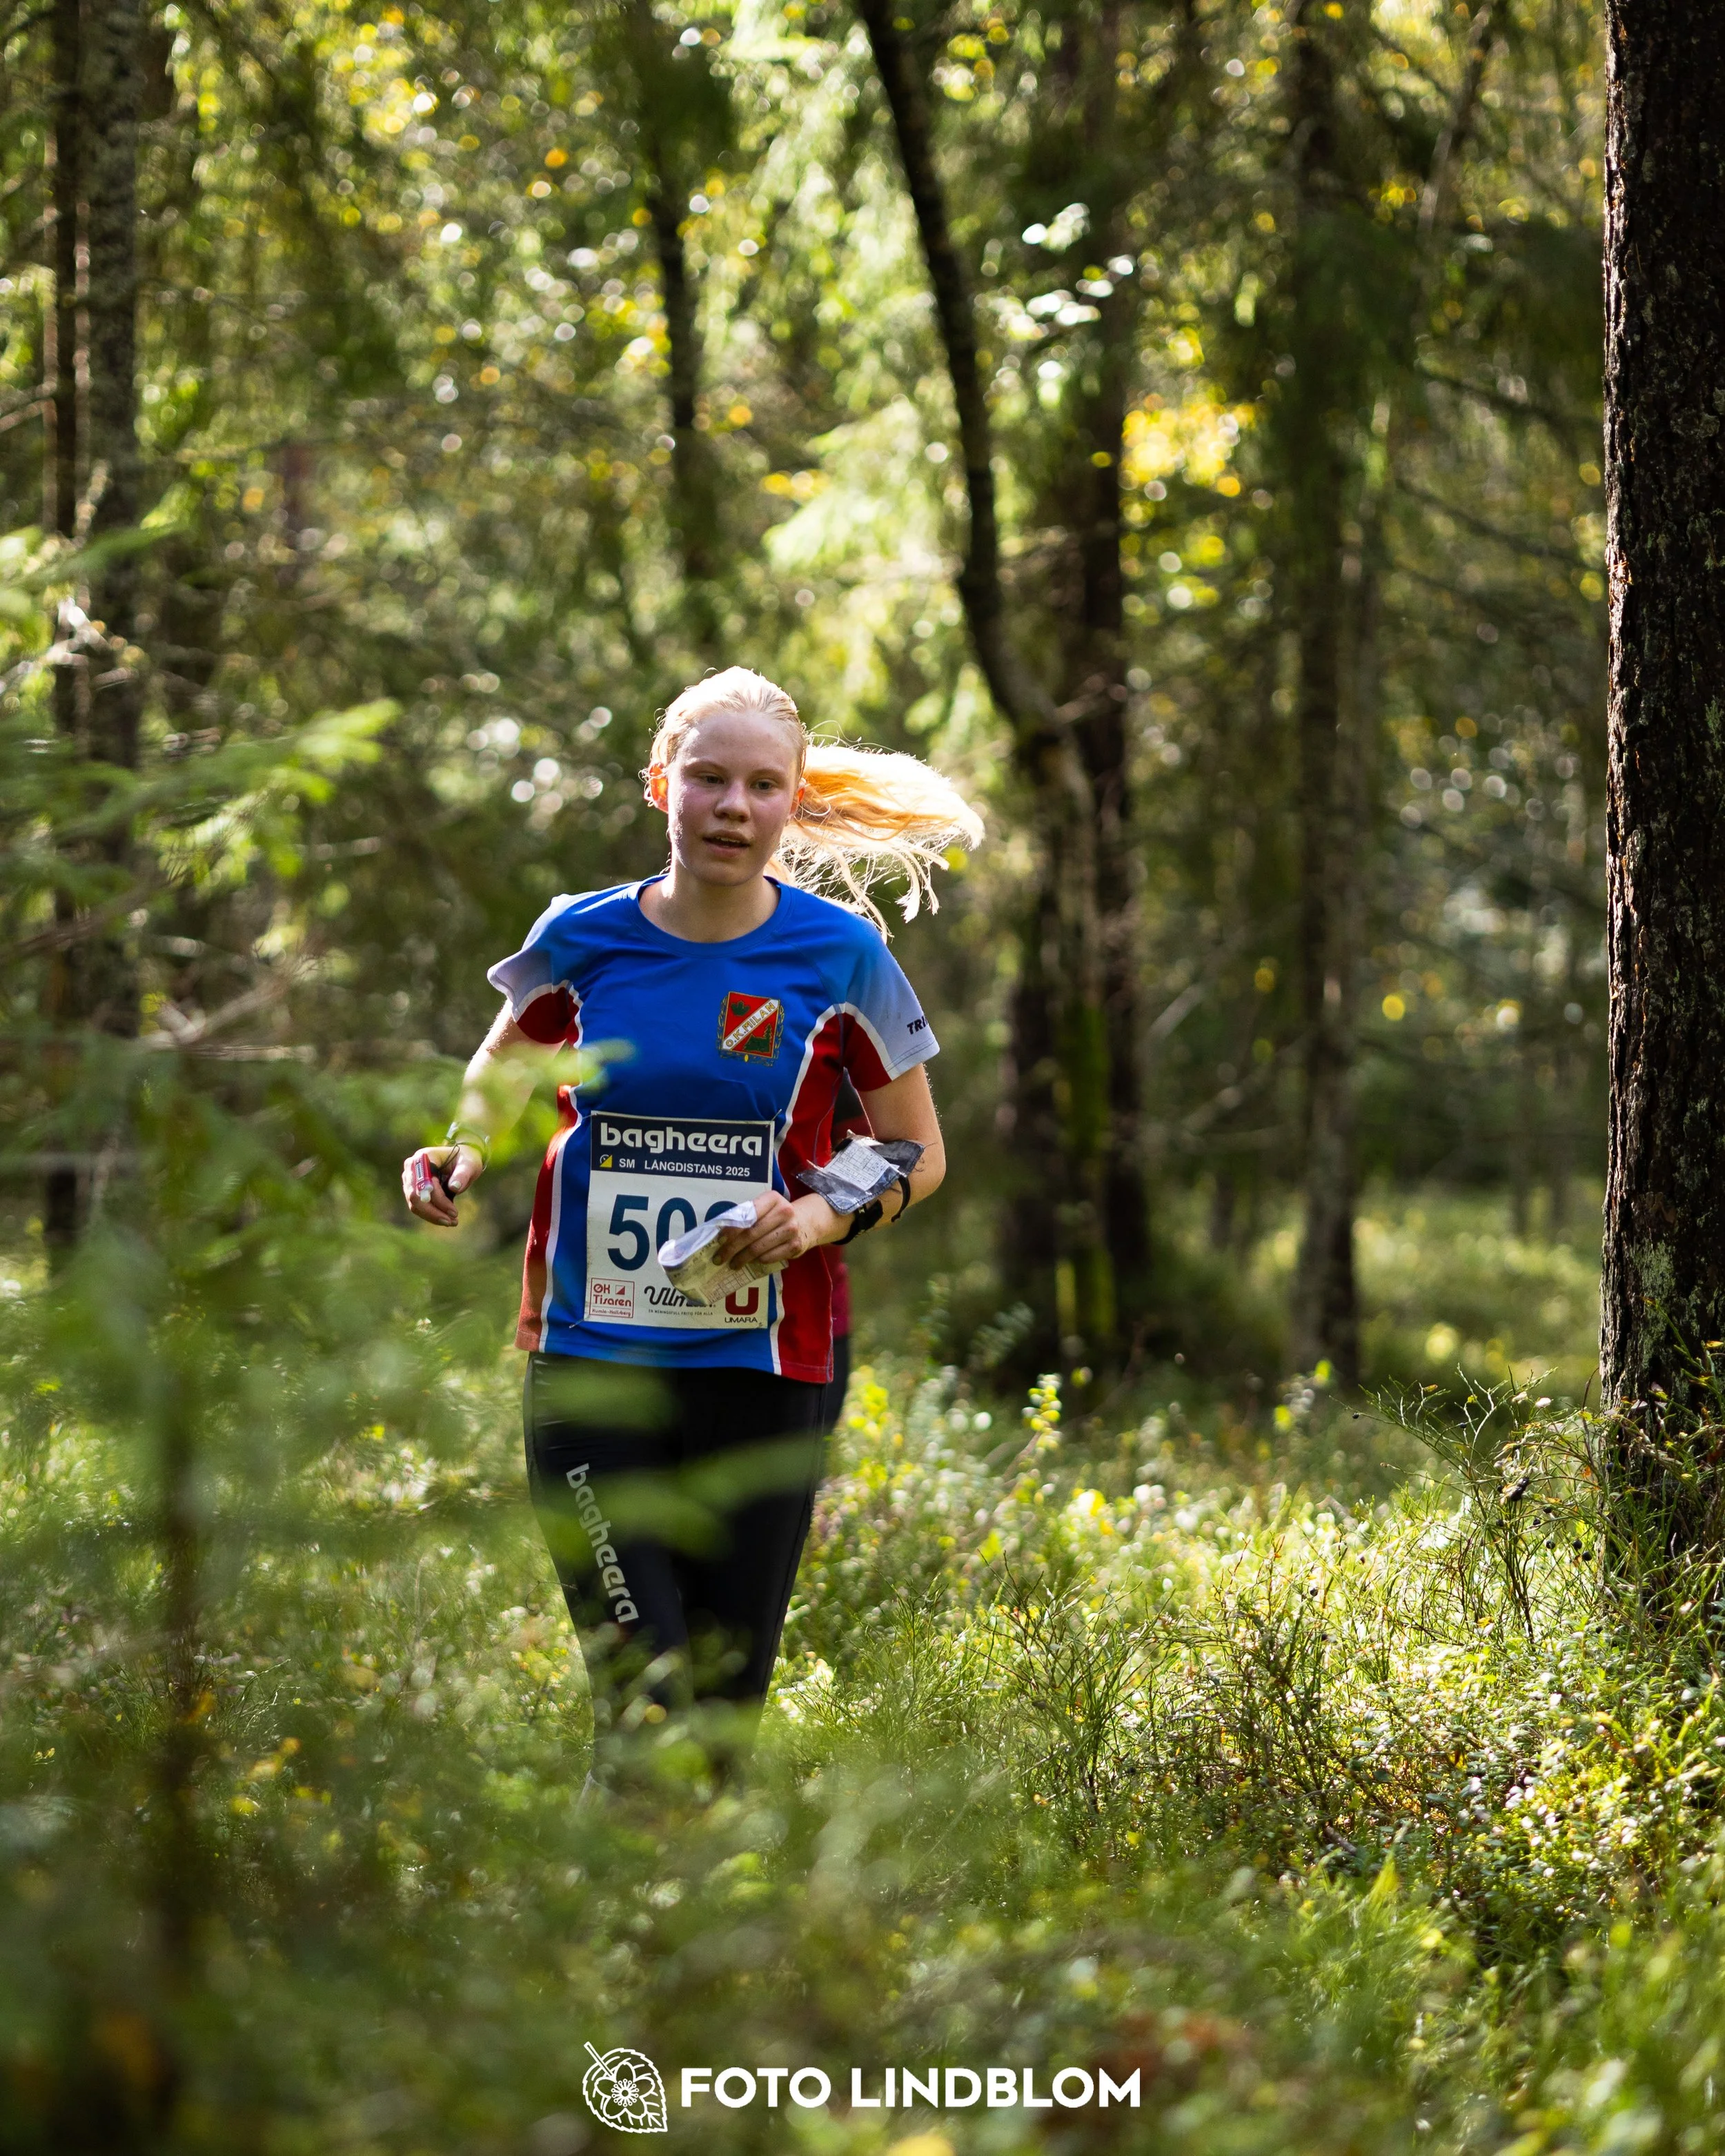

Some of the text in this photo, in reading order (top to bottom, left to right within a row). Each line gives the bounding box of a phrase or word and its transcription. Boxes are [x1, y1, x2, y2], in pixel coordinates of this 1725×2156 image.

[600, 1122, 762, 1156] bagheera
[619, 1158, 750, 1177] SM LÅNGDISTANS 2025
[607, 1194, 739, 1272] 50
[593, 1294, 632, 1307] Tisaren
[566, 1463, 640, 1623] bagheera
